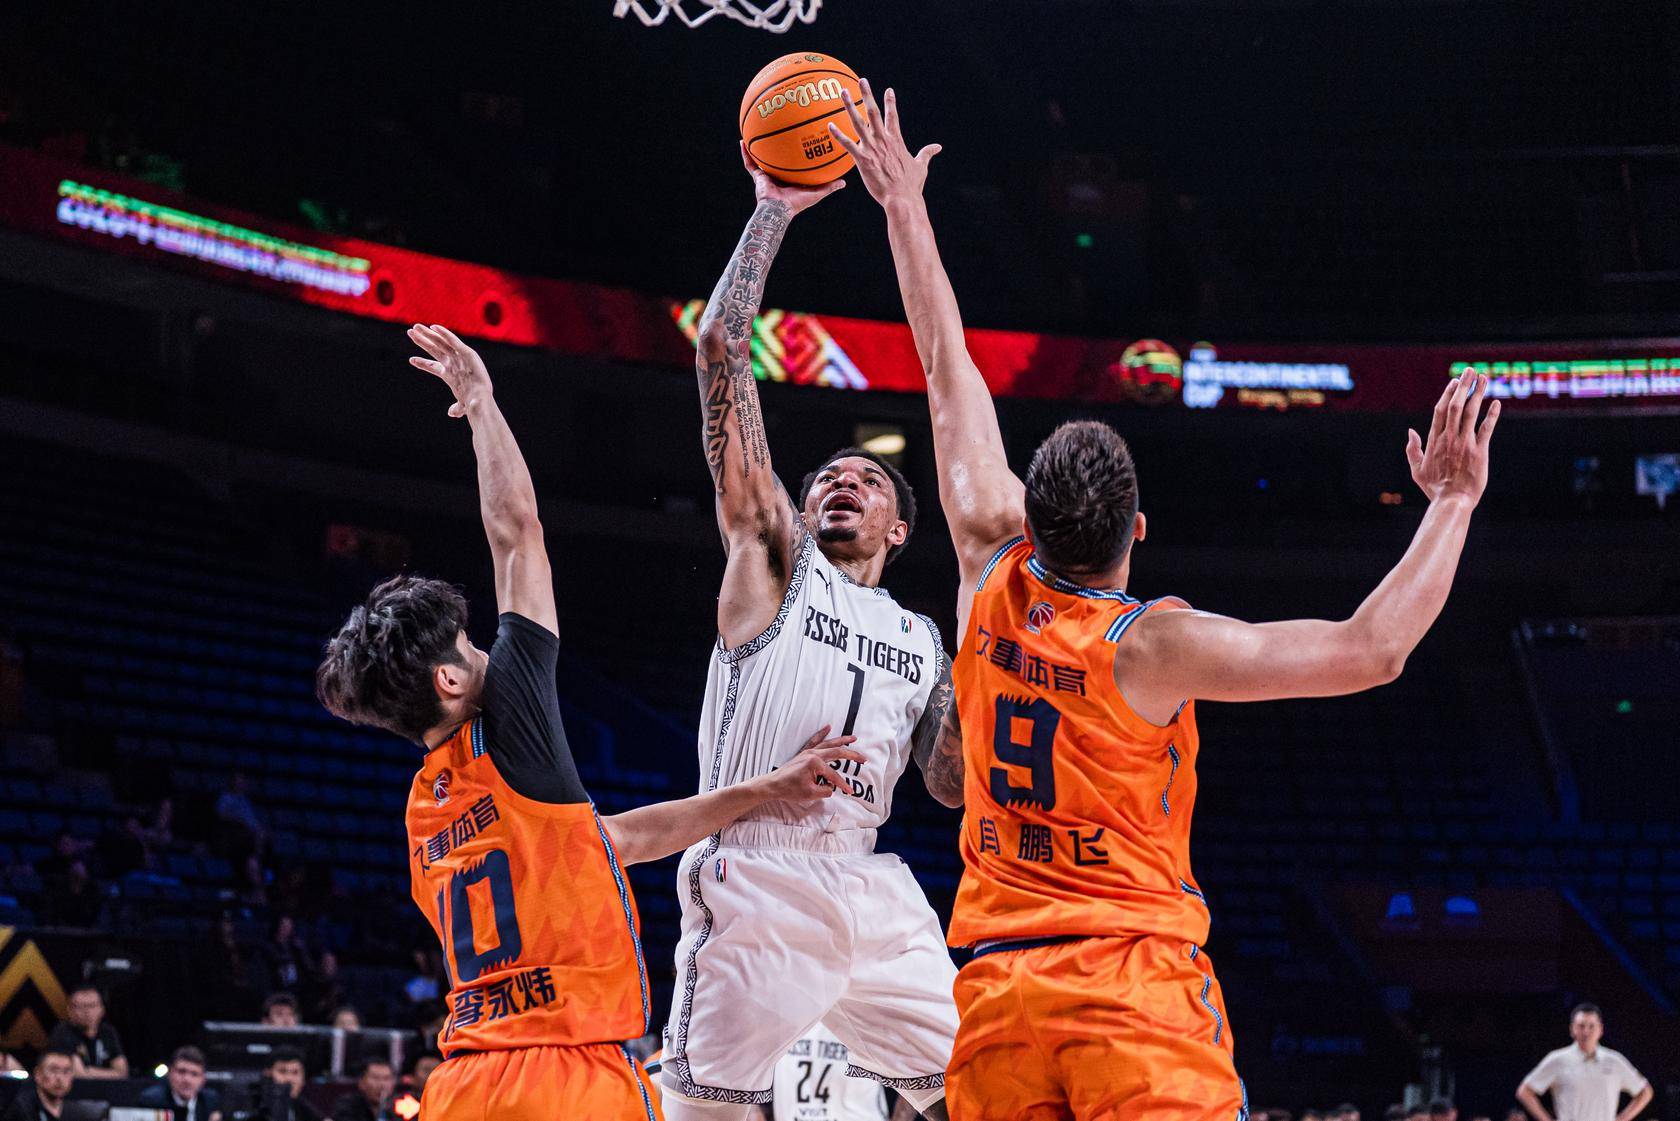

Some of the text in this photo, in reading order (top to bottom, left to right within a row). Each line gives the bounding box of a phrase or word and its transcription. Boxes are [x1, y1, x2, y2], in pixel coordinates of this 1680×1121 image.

[757, 77, 842, 119] Wilson
[805, 141, 834, 160] FIBA
[856, 633, 924, 685] TIGERS
[841, 662, 865, 746] 1
[990, 693, 1061, 812] 9
[797, 1060, 832, 1104] 24
